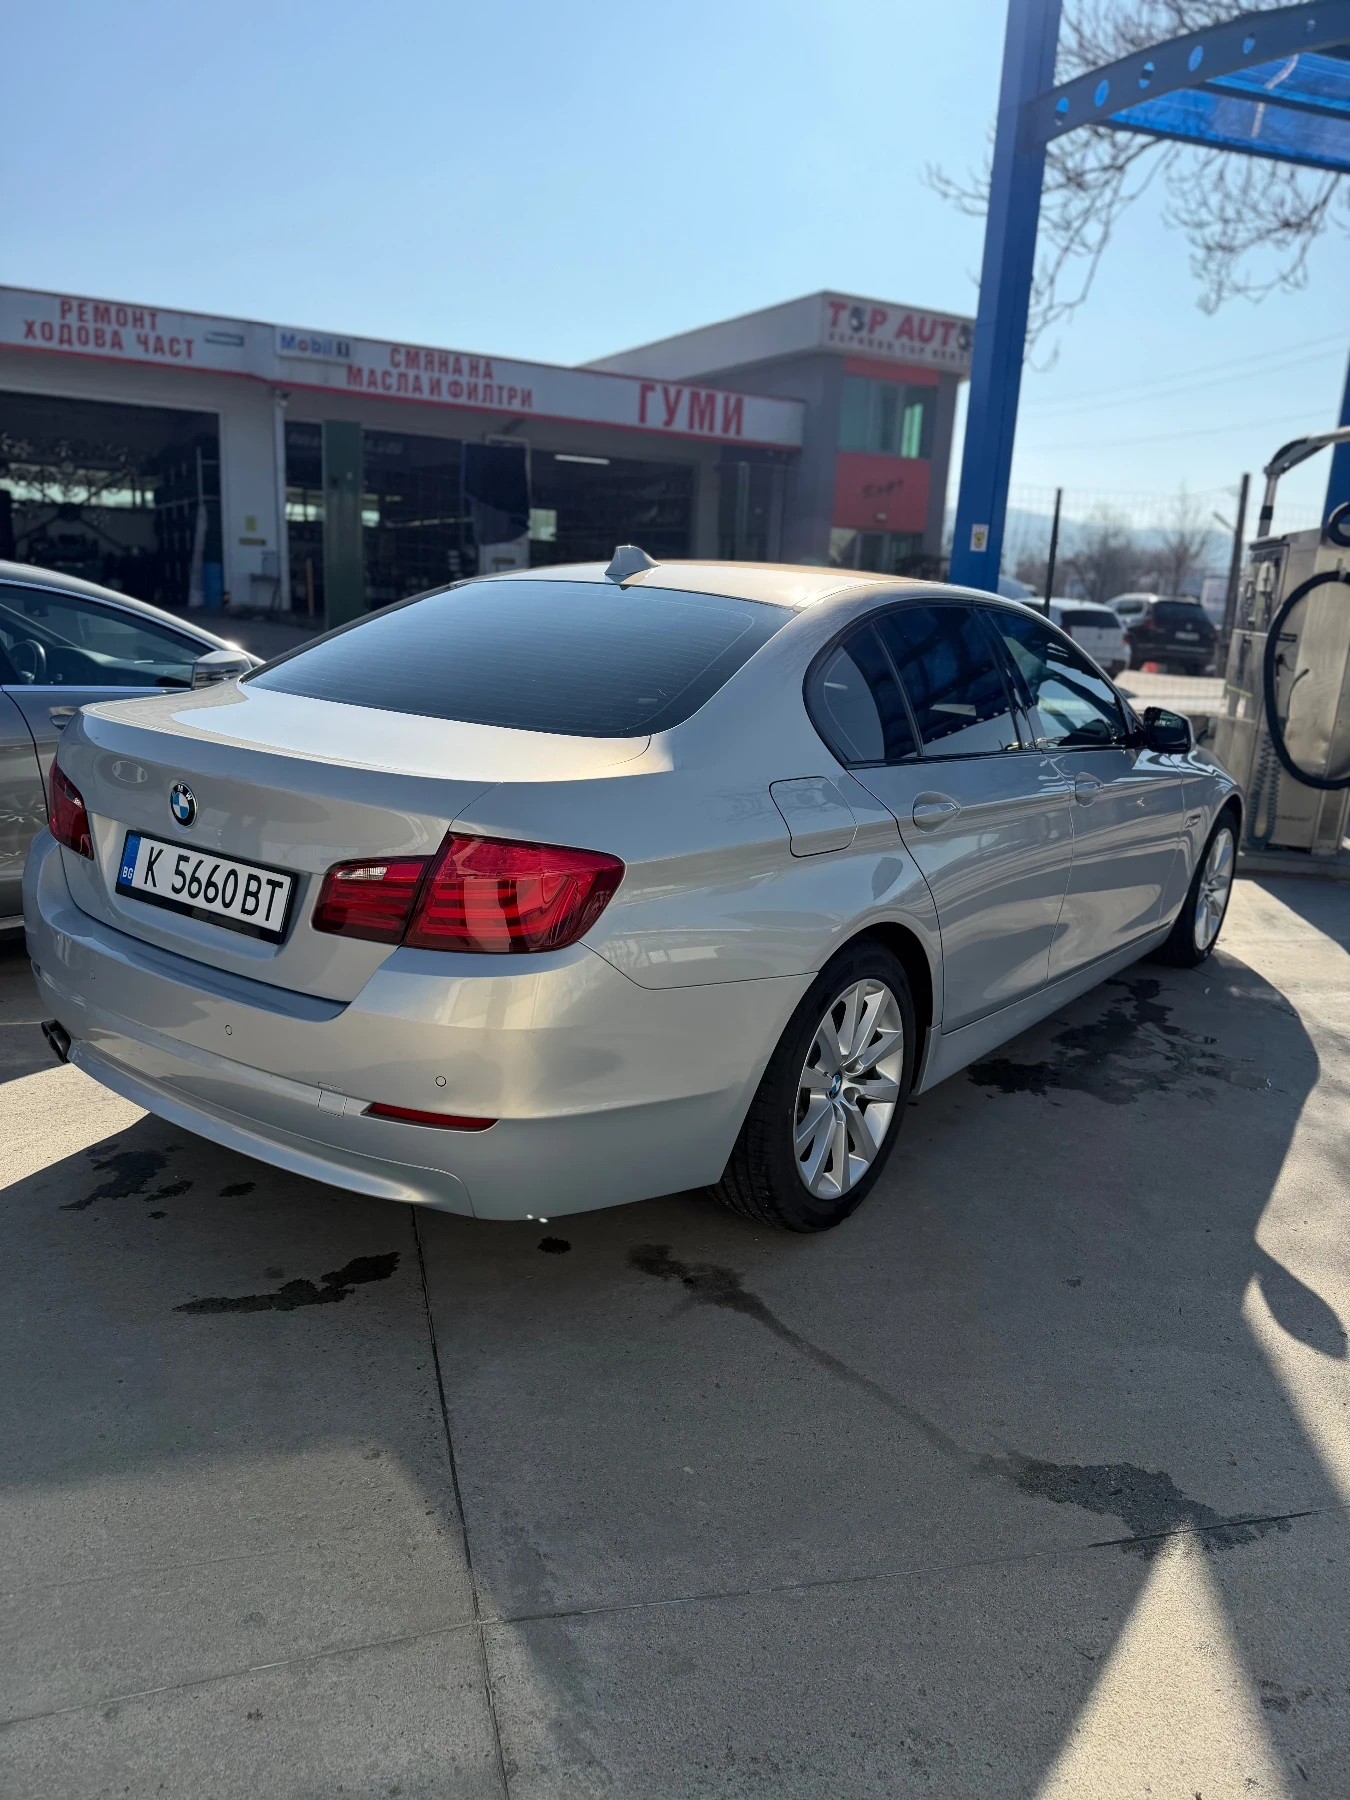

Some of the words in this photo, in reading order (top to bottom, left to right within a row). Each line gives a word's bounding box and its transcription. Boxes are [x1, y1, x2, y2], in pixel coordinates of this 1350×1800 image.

[58, 299, 160, 332] РЕМОНТ
[23, 319, 124, 351] ХОДОВА
[136, 332, 195, 359] ЧАСТ
[280, 333, 333, 357] Mobil
[389, 347, 463, 377] СМЯНА
[468, 359, 495, 381] НА
[346, 364, 424, 397] МАСЛА
[428, 376, 442, 398] И
[446, 377, 534, 409] ФИЛТРИ
[638, 383, 744, 436] ГУМИ
[122, 866, 134, 880] BG
[143, 846, 165, 888] K
